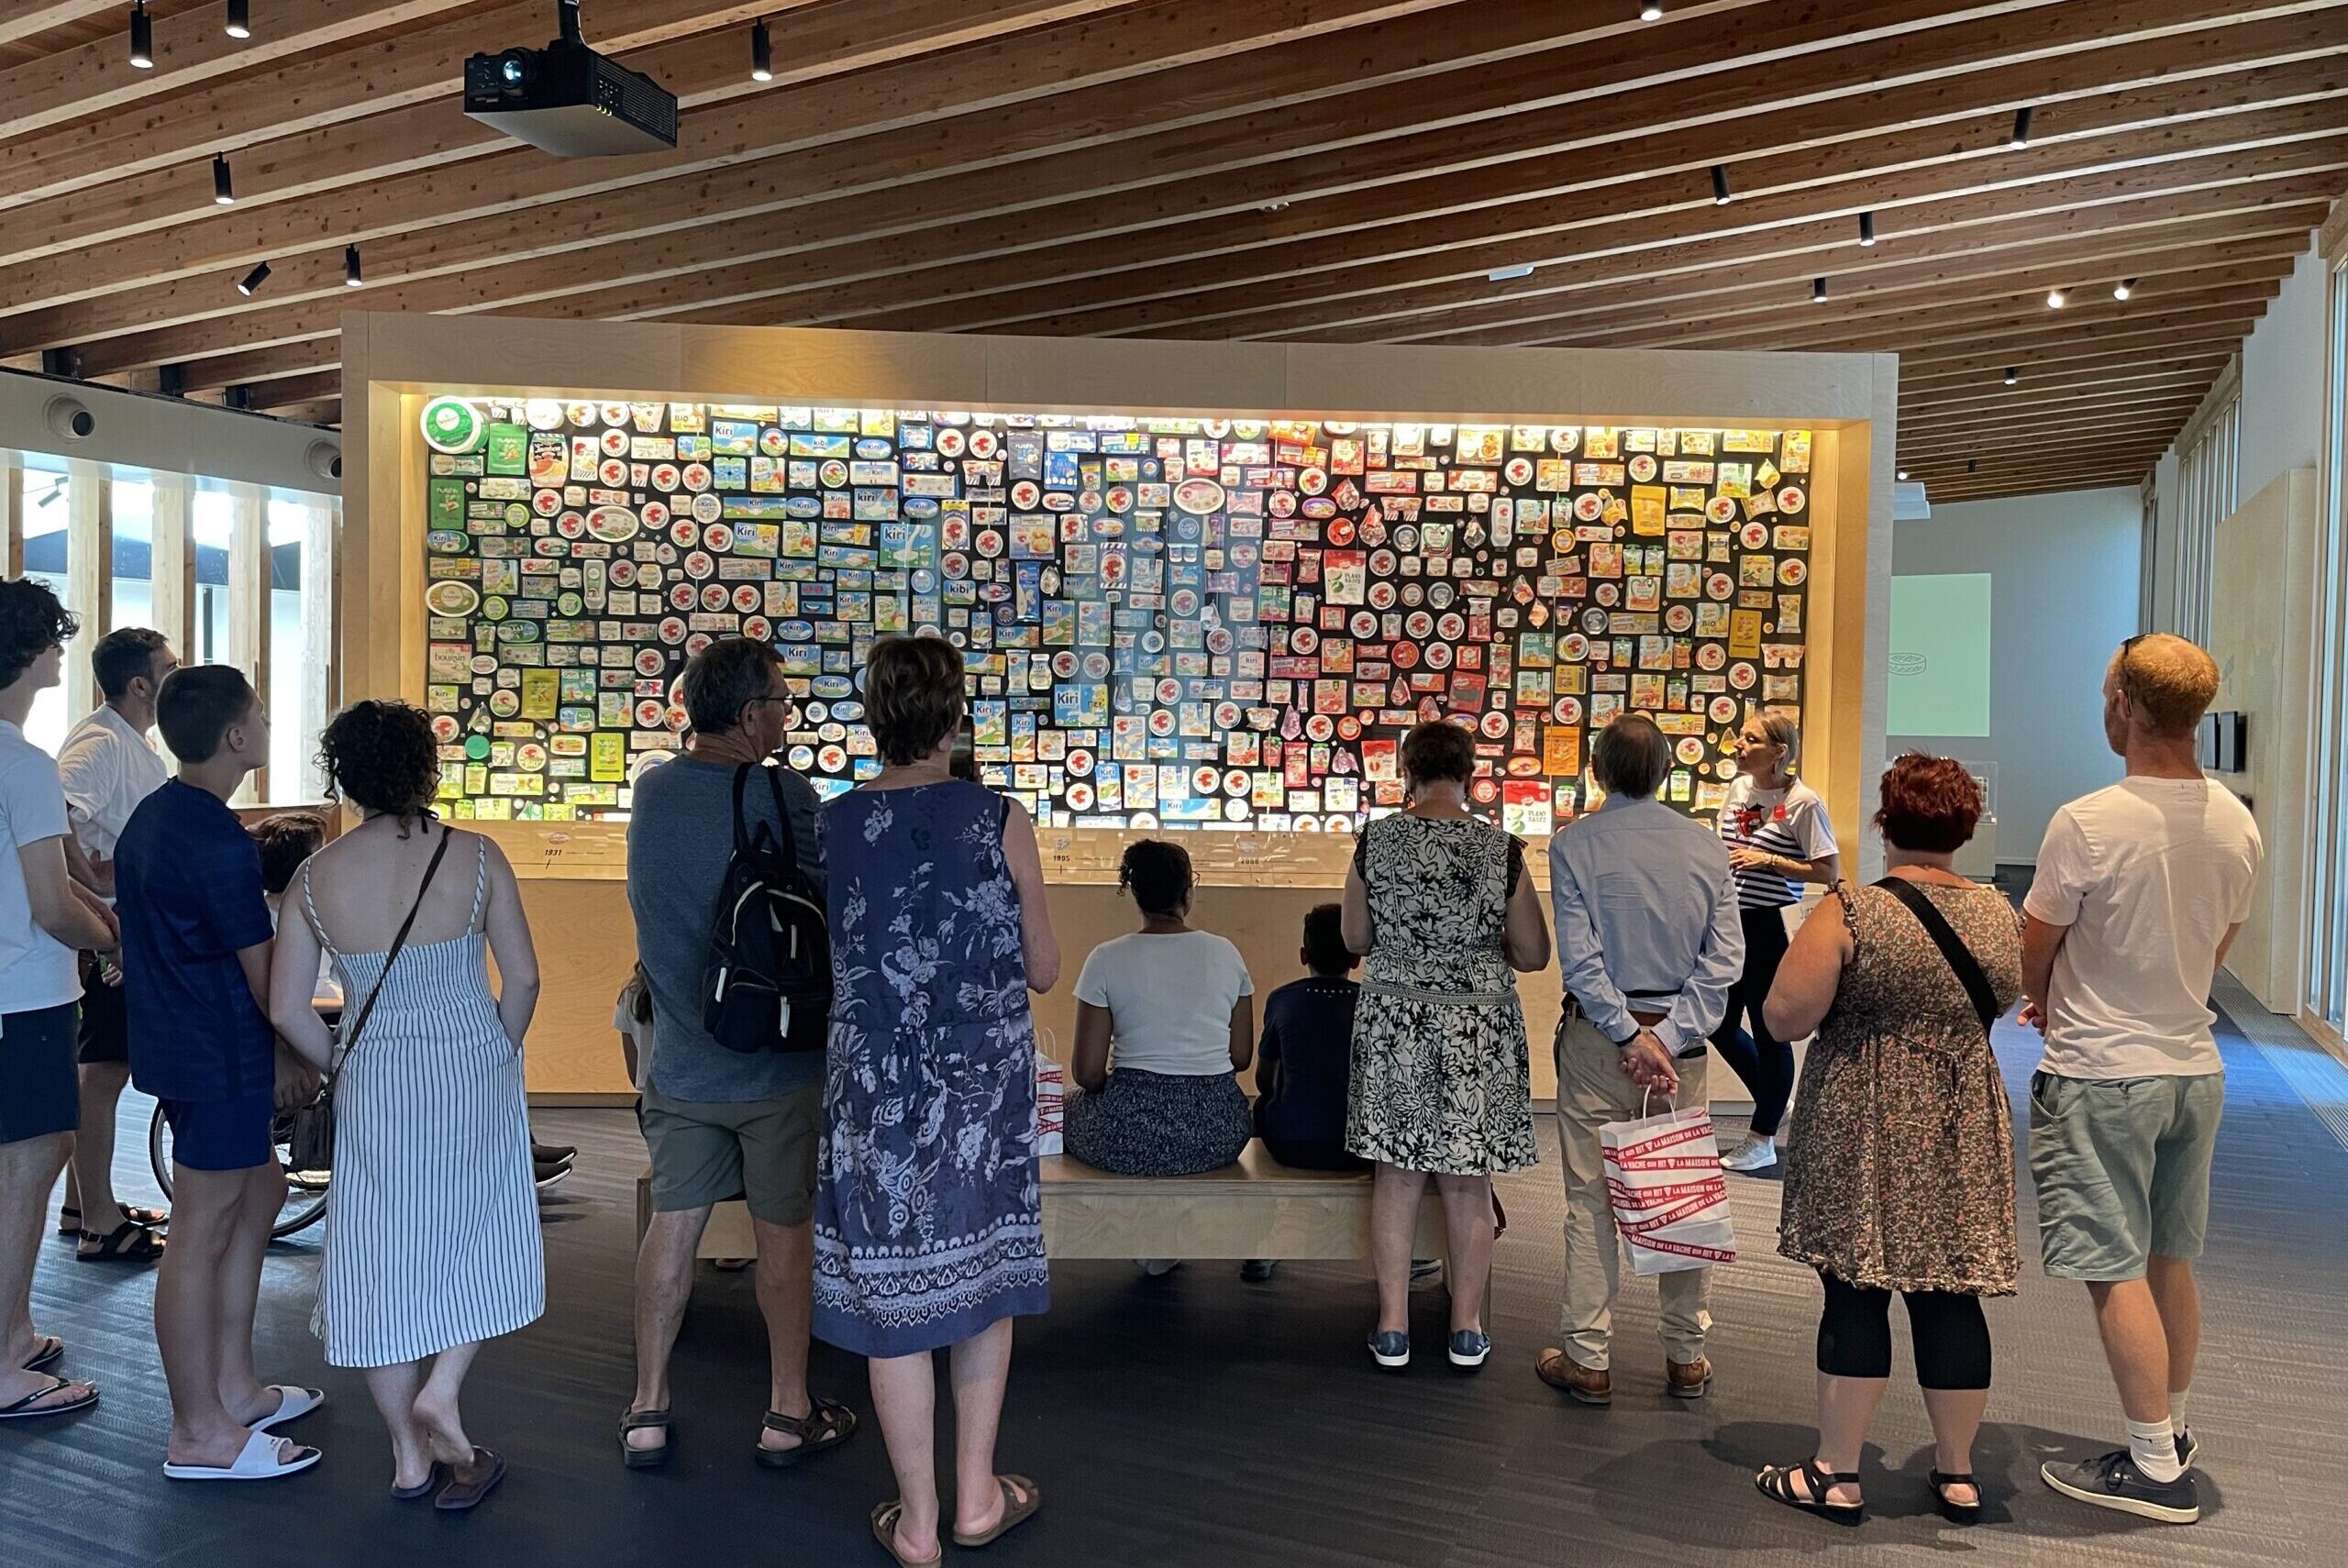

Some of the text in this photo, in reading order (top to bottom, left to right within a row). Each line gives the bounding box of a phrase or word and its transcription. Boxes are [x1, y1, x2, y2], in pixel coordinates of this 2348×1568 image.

[715, 425, 734, 436] Kiri
[858, 492, 876, 502] kiri
[737, 525, 756, 537] Kiri
[822, 524, 837, 533] Kiri
[885, 527, 907, 540] kiri
[433, 534, 448, 542] Kiri
[950, 582, 969, 594] kibi
[789, 623, 803, 631] kiri
[999, 629, 1015, 638] Kiri
[788, 647, 808, 658] Kiri
[824, 680, 839, 688] Kiri
[1057, 693, 1079, 705] Kiri
[976, 705, 992, 714] Kiri
[1015, 718, 1031, 727] Kiri
[1102, 767, 1115, 775] Kiri
[812, 781, 830, 791] Kiri
[1167, 801, 1182, 809] Kiri
[1635, 1144, 1645, 1154] RIT
[1654, 1140, 1661, 1148] LA
[1661, 1132, 1684, 1146] MAISON
[1692, 1128, 1701, 1137] LA
[1685, 1158, 1710, 1167] MAISON
[1653, 1188, 1663, 1197] RIT
[1680, 1185, 1705, 1194] MAISON
[1649, 1220, 1660, 1230] RIT
[1676, 1203, 1699, 1218] MAISON
[1706, 1195, 1714, 1204] LA
[1632, 1234, 1656, 1248] MAISON
[1672, 1244, 1692, 1254] VACHE
[1702, 1248, 1713, 1258] RIT
